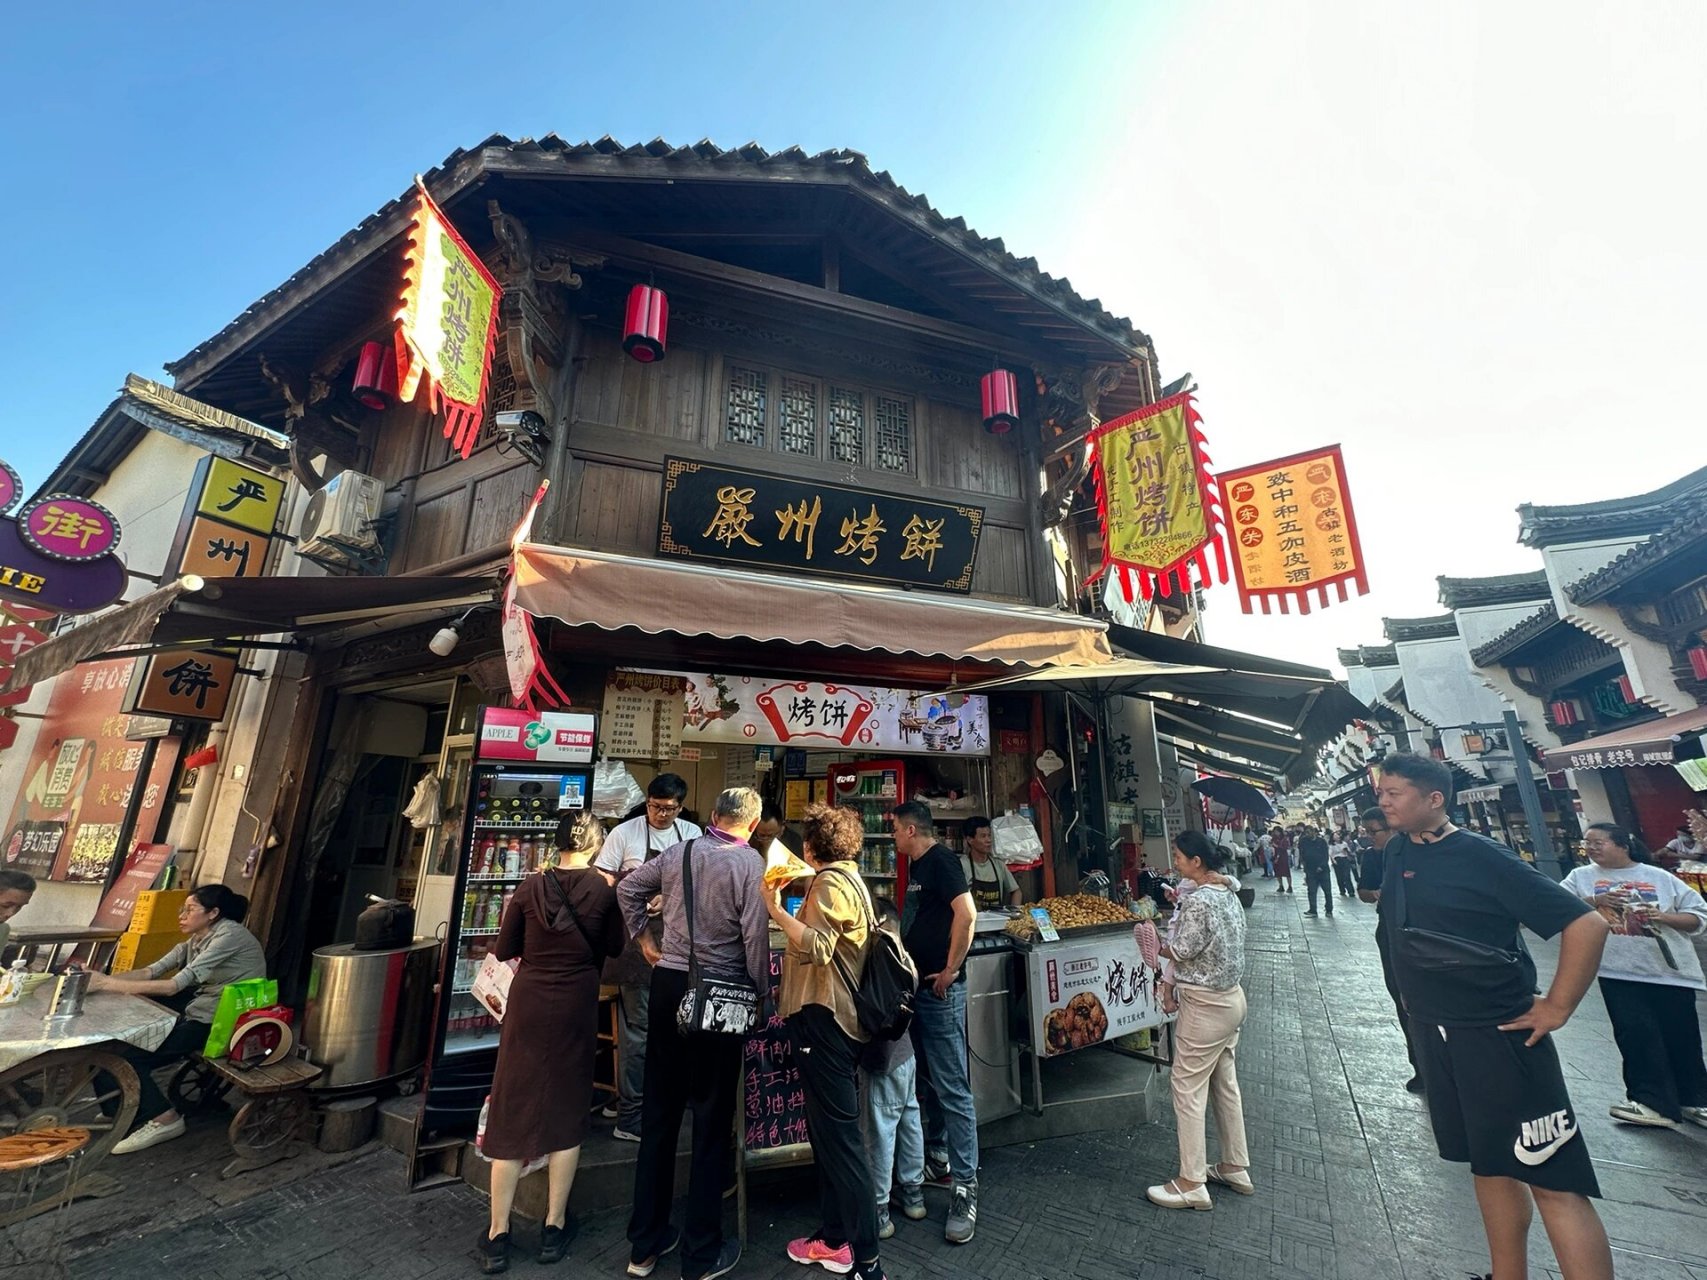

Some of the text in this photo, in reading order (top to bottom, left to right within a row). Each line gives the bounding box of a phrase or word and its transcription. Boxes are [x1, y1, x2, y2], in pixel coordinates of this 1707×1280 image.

[1125, 428, 1173, 537] 严州烤饼
[1173, 442, 1199, 517] 古镇特产
[37, 506, 104, 550] 街
[702, 485, 945, 572] 嚴州烤餅
[1266, 471, 1312, 583] 致中和五加皮酒
[616, 672, 680, 690] 严州烤饼价目表
[788, 696, 849, 728] 烤饼
[486, 727, 513, 739] APPLE
[967, 720, 986, 748] 美食
[1607, 749, 1635, 764] 老字号
[21, 830, 63, 853] 梦幻乐园
[1105, 959, 1149, 1007] 烧饼
[1521, 1108, 1572, 1147] NIKE
